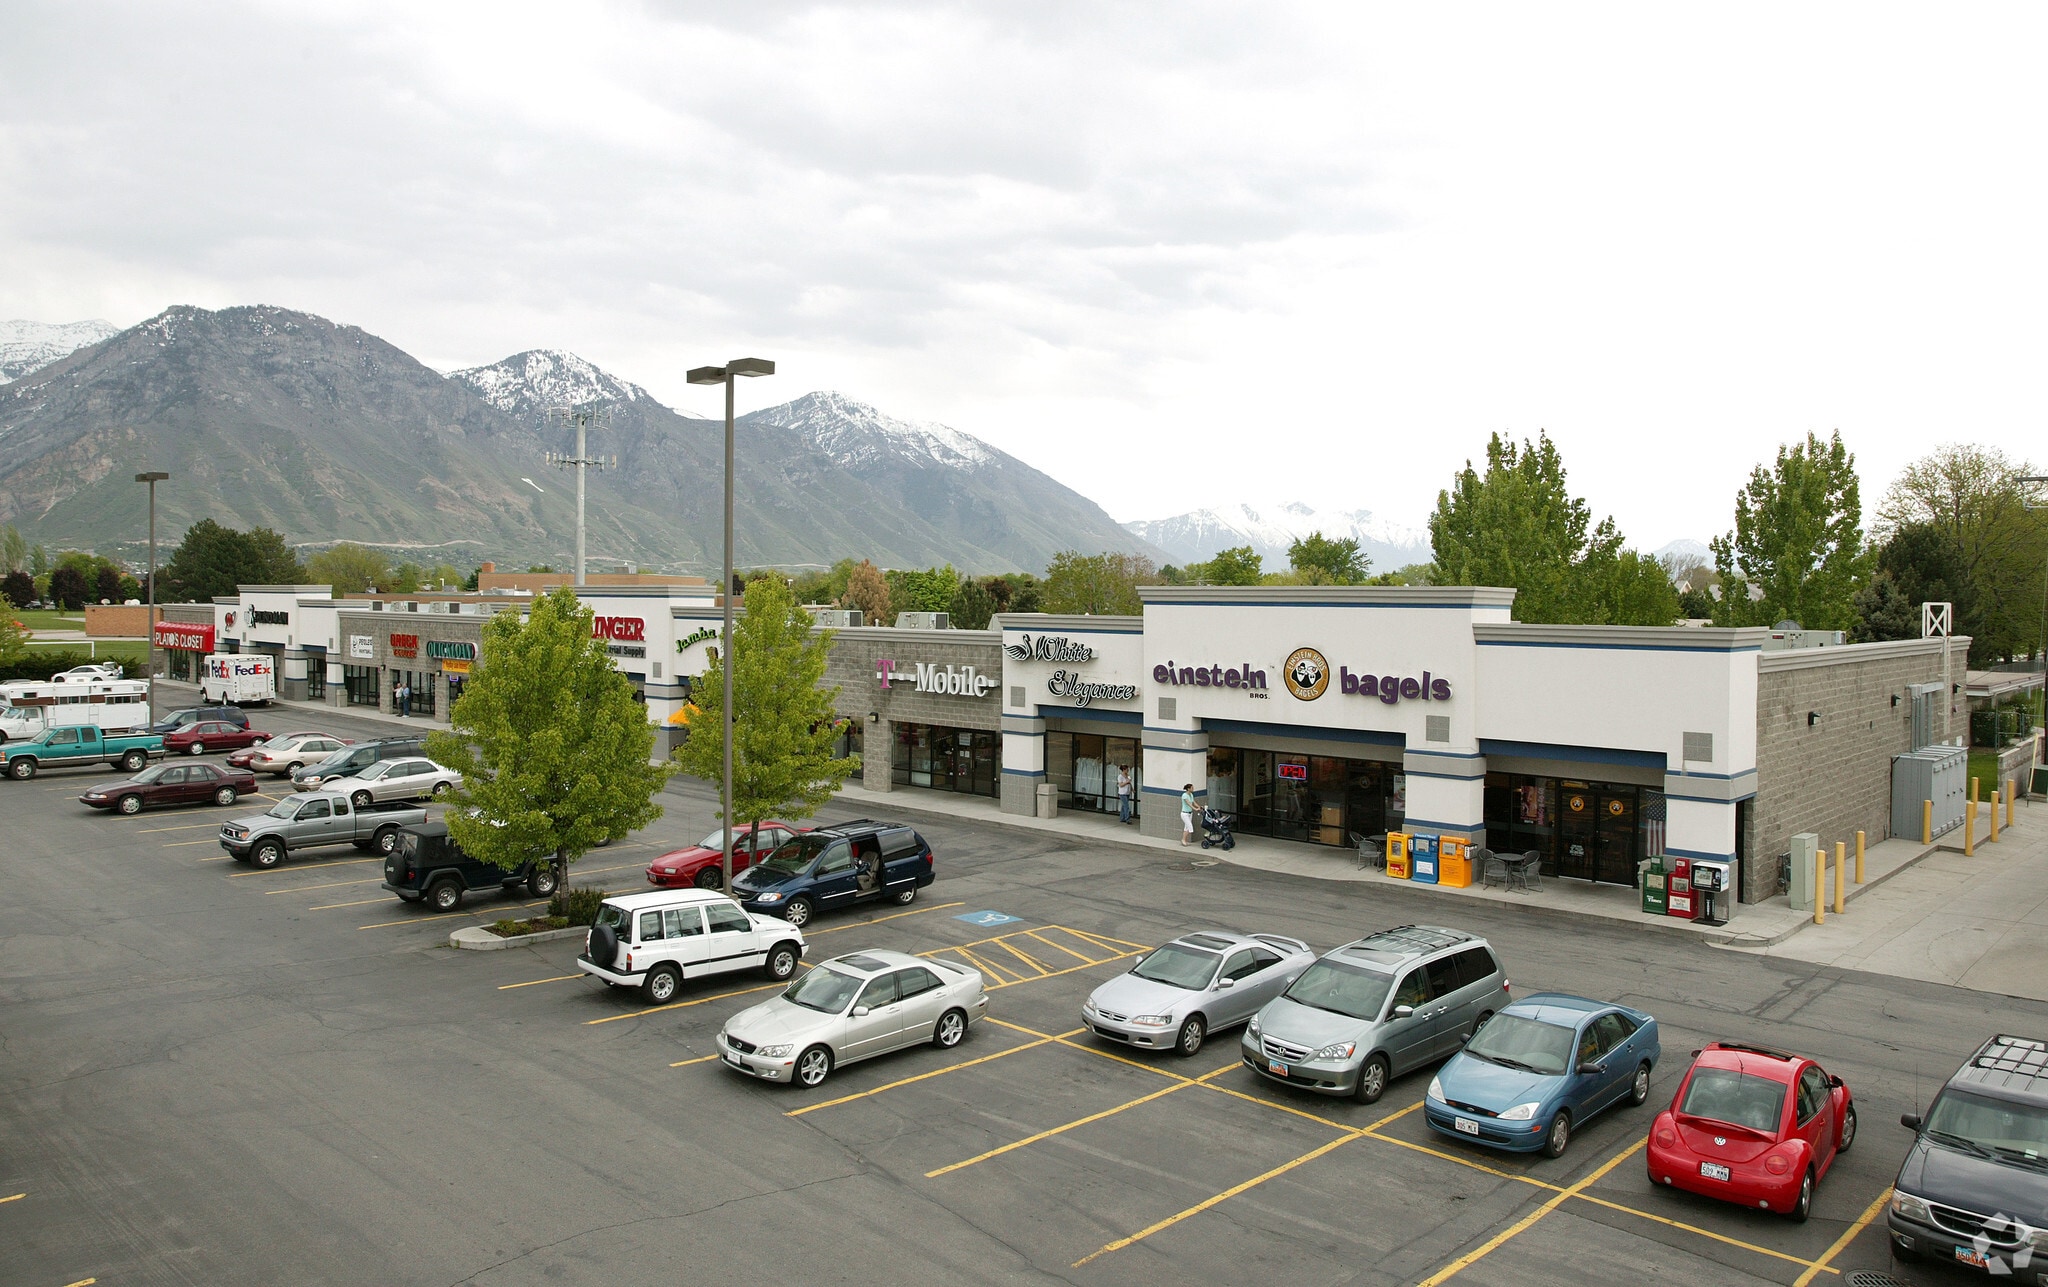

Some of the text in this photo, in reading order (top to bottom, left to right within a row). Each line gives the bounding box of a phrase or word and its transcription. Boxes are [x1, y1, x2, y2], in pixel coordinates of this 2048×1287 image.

[591, 616, 645, 641] INGER
[155, 631, 204, 649] PLATO'S CLOSET
[676, 626, 718, 653] Jamba
[1035, 635, 1092, 662] White
[606, 645, 645, 658] trial Supply
[1287, 651, 1312, 670] EINSTEIN
[211, 660, 230, 679] FedEx
[235, 664, 271, 676] FedEx
[1048, 669, 1135, 707] Elegance
[1294, 687, 1319, 697] BAGELS
[1340, 666, 1452, 704] bagels
[1280, 766, 1306, 778] OPEN
